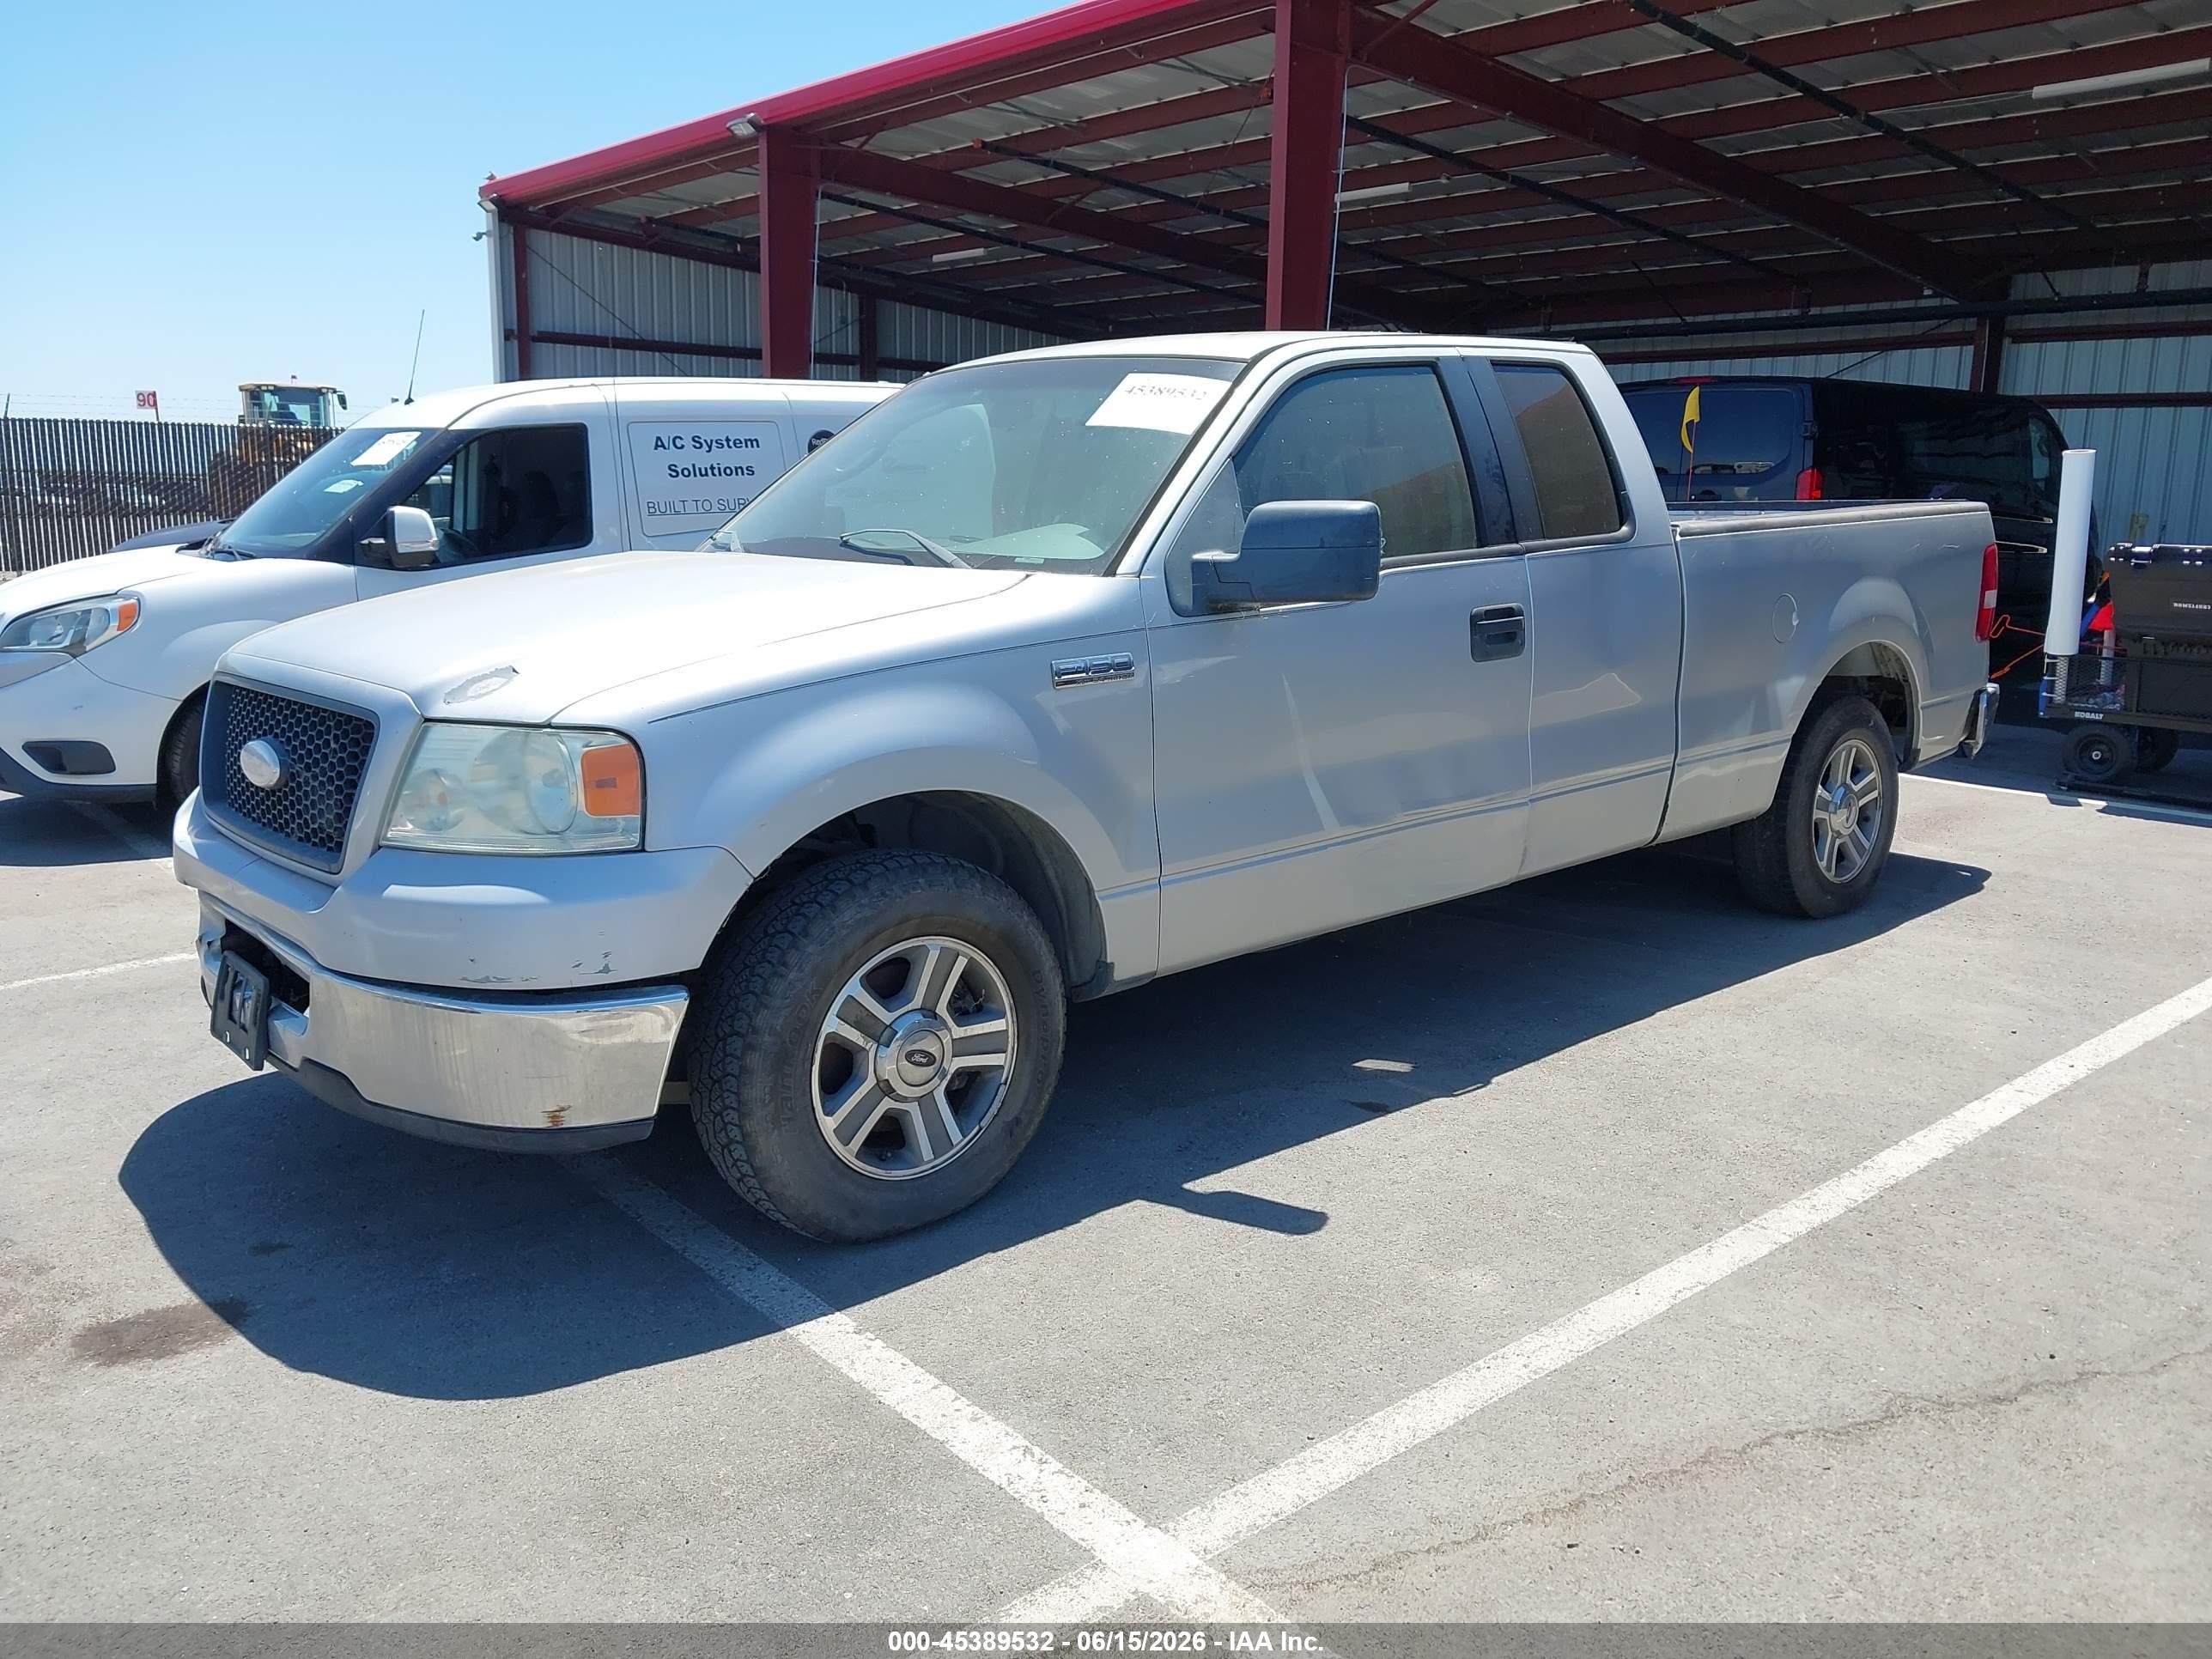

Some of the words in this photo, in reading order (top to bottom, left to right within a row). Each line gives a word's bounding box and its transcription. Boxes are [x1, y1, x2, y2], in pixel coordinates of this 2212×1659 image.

[137, 392, 156, 407] 90
[653, 434, 685, 451] A/C
[691, 434, 761, 453] System
[667, 463, 756, 478] Solutions
[647, 500, 689, 514] BUILT
[691, 499, 713, 513] TO
[717, 497, 750, 512] SUR
